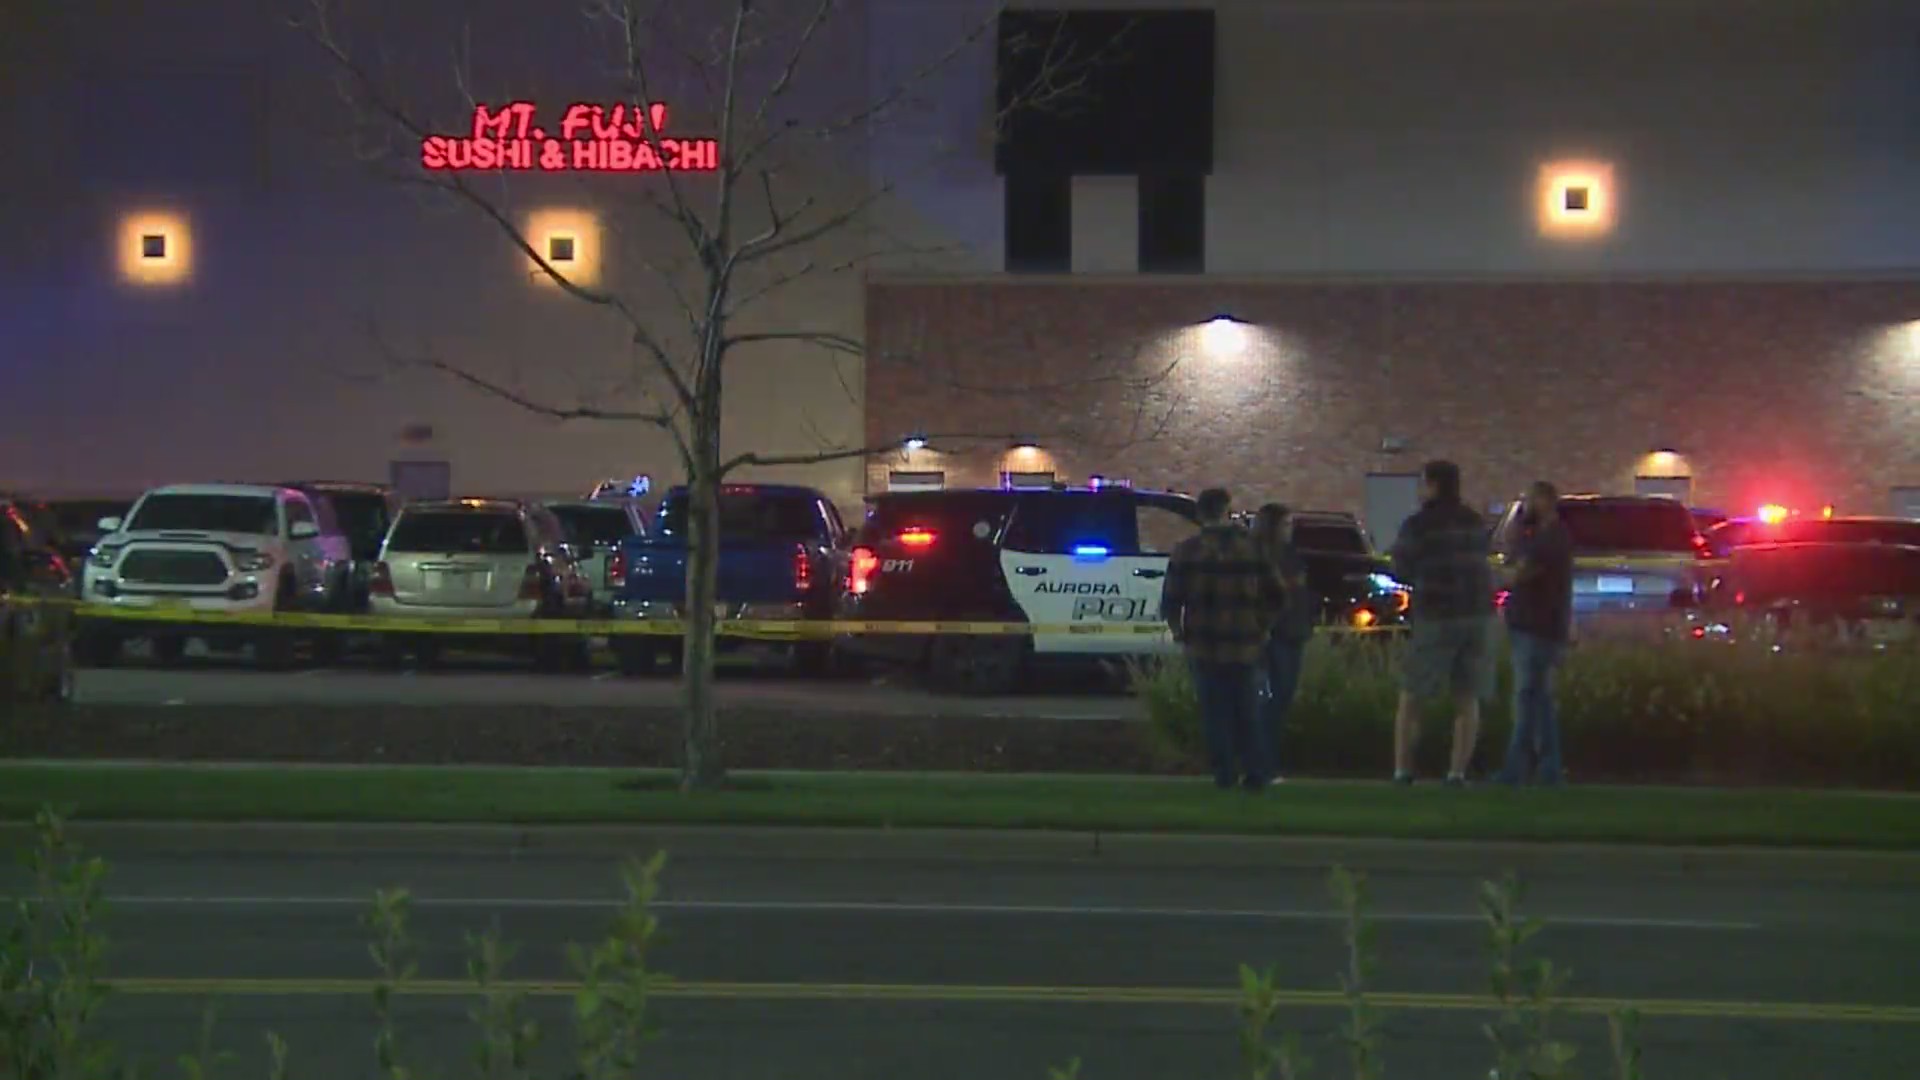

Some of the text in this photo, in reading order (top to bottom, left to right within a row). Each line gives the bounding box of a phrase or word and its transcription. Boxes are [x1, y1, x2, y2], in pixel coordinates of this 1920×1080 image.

[472, 102, 546, 140] MT.
[422, 136, 718, 169] SUSHI & HIBACHI
[1034, 582, 1121, 595] AURORA
